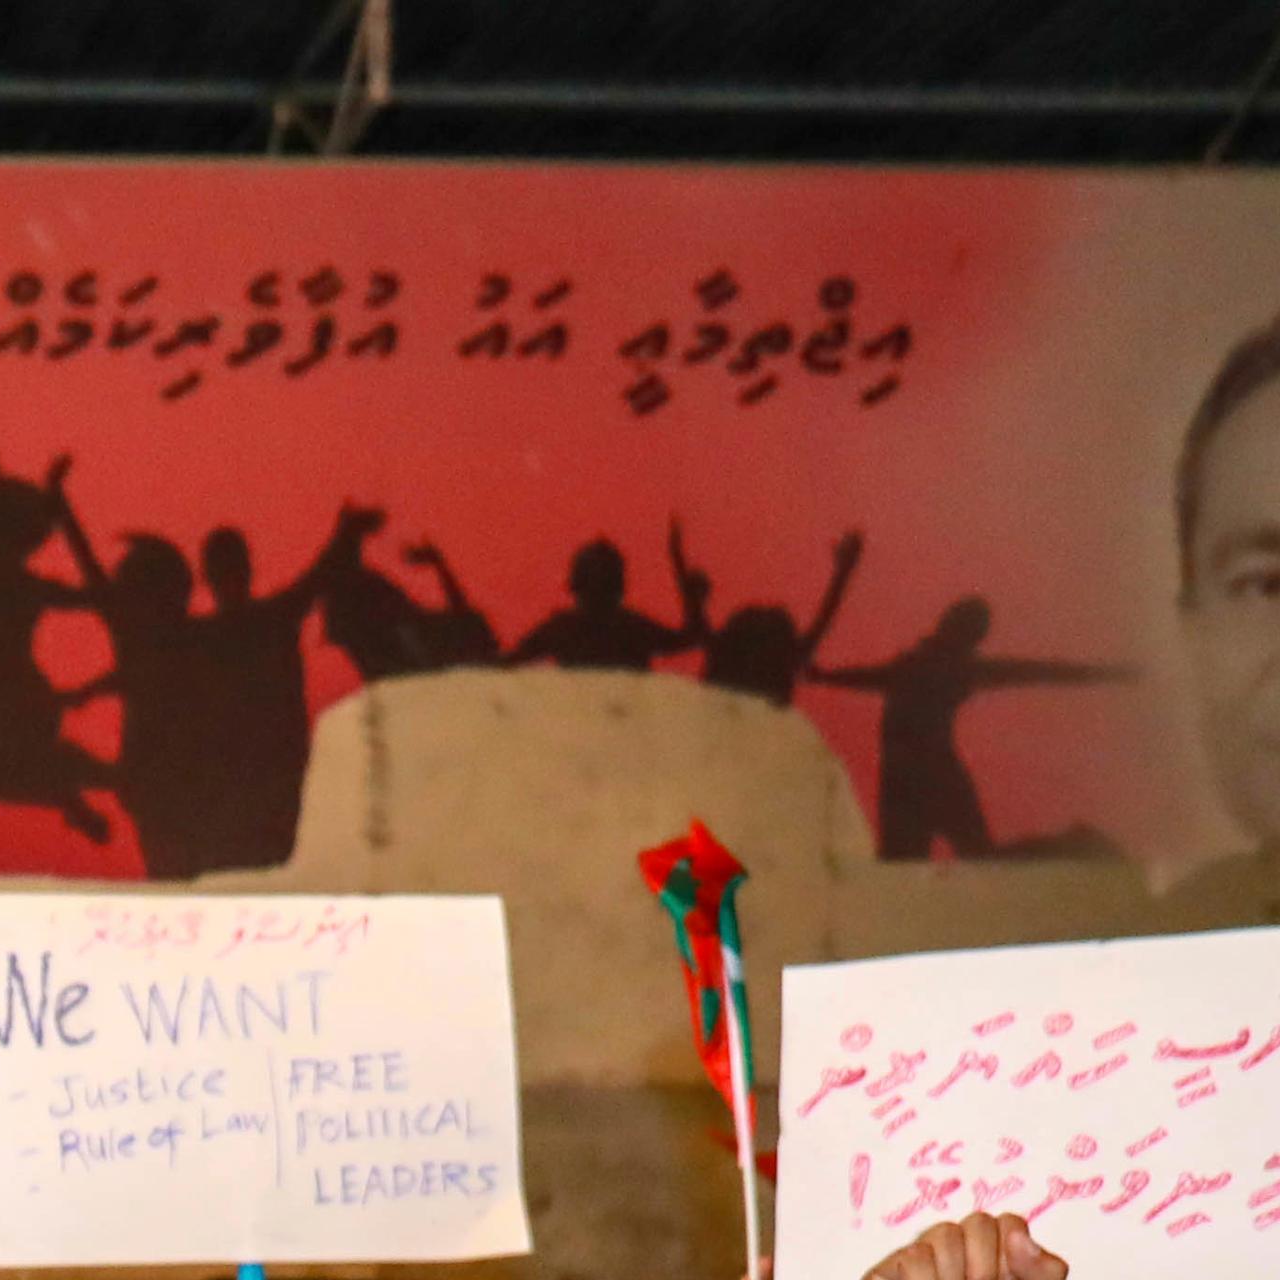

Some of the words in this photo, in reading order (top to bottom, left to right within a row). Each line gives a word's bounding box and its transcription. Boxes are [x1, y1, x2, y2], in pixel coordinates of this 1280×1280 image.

[118, 970, 334, 1047] WANT
[48, 1066, 228, 1120] Justice
[287, 1051, 411, 1100] FREE
[57, 1126, 138, 1172] Rule
[145, 1119, 184, 1168] of
[200, 1106, 268, 1138] Law
[293, 1100, 488, 1157] POLITICAL
[312, 1161, 502, 1206] LEADERS
